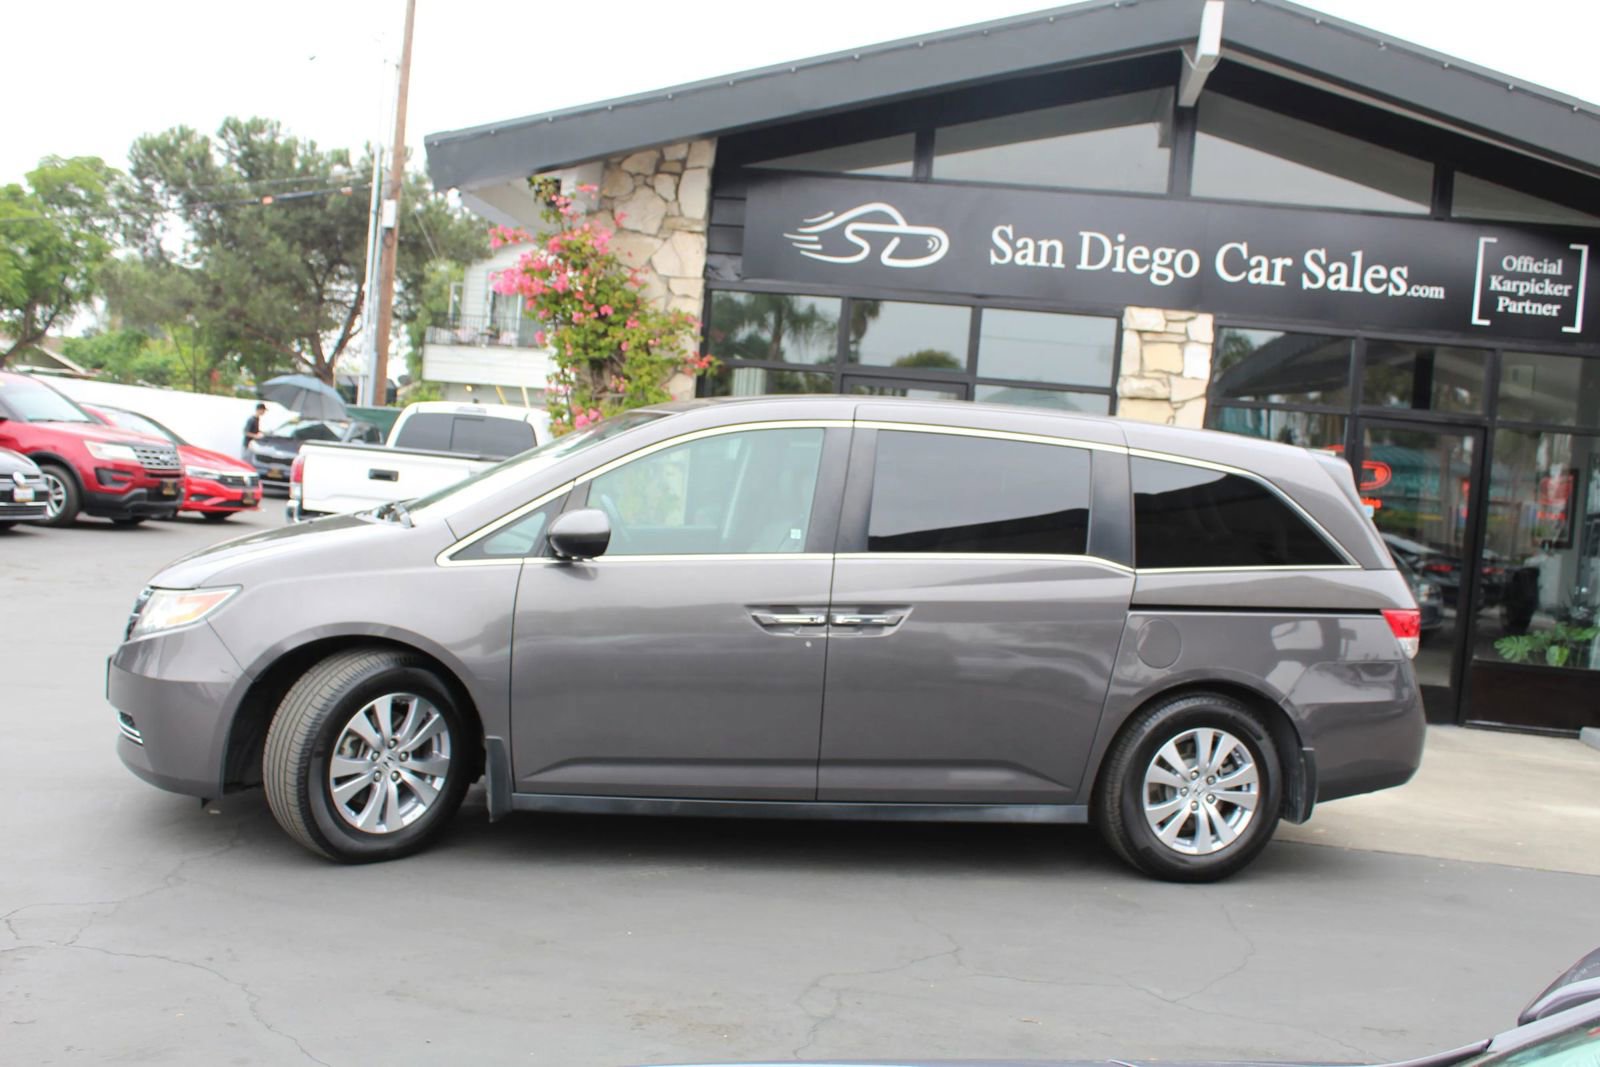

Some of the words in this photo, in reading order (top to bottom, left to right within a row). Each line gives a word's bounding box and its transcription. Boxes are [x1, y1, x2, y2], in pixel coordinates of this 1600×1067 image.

[988, 223, 1066, 269] San
[1075, 228, 1201, 286] Diego
[1214, 241, 1294, 287] Car
[1501, 254, 1563, 276] Official
[1489, 274, 1573, 297] Karpicker
[1497, 295, 1561, 317] Partner
